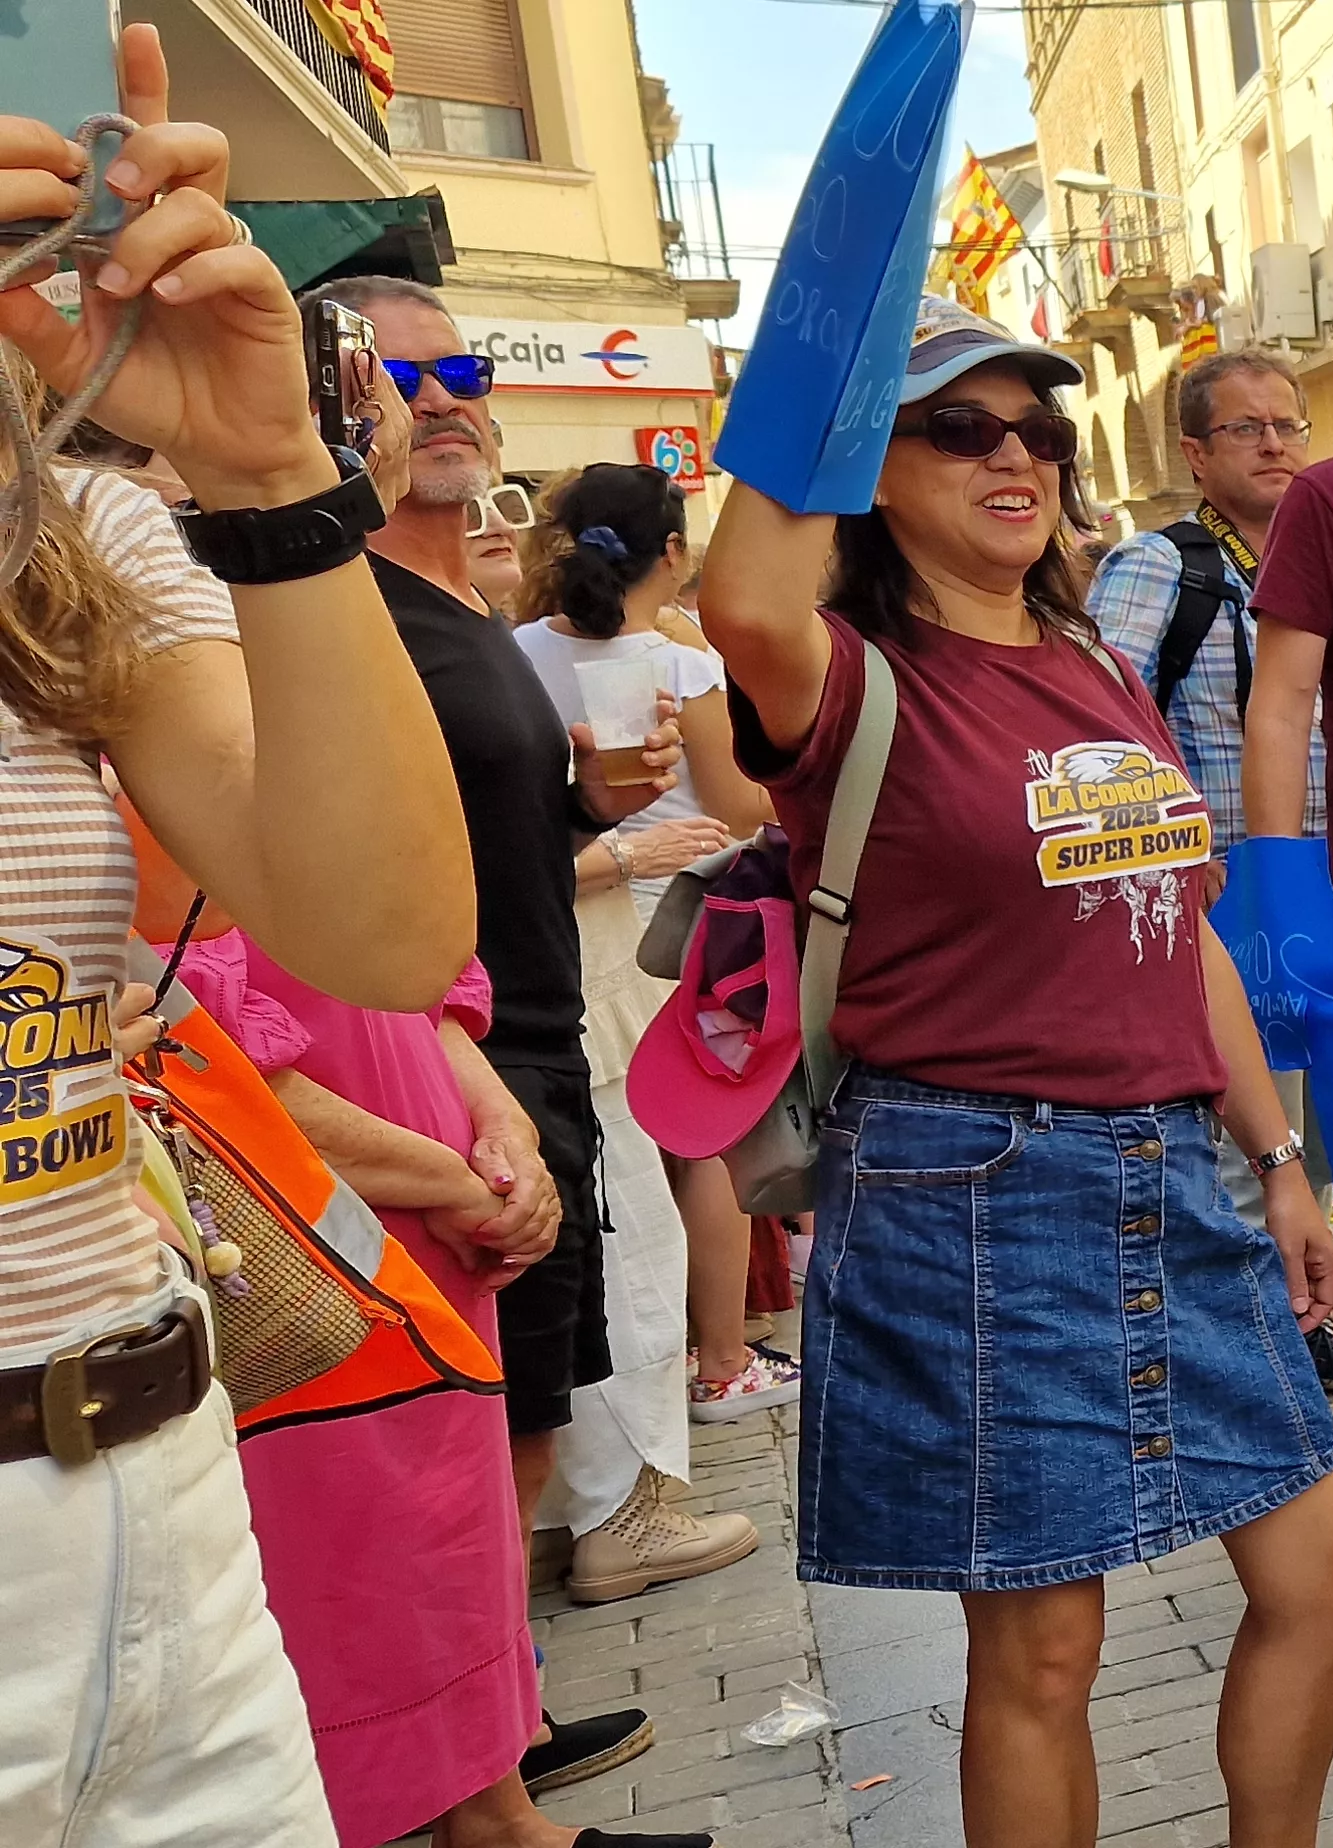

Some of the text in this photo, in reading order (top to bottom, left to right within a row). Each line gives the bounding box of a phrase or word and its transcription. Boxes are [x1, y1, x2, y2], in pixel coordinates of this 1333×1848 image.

[1224, 533, 1258, 570] Nikon
[1038, 769, 1191, 818] LA CORONA
[1101, 805, 1161, 832] 2025
[1056, 825, 1202, 870] SUPER BOWL
[0, 1002, 112, 1070] ONA
[3, 1110, 116, 1185] BOWL
